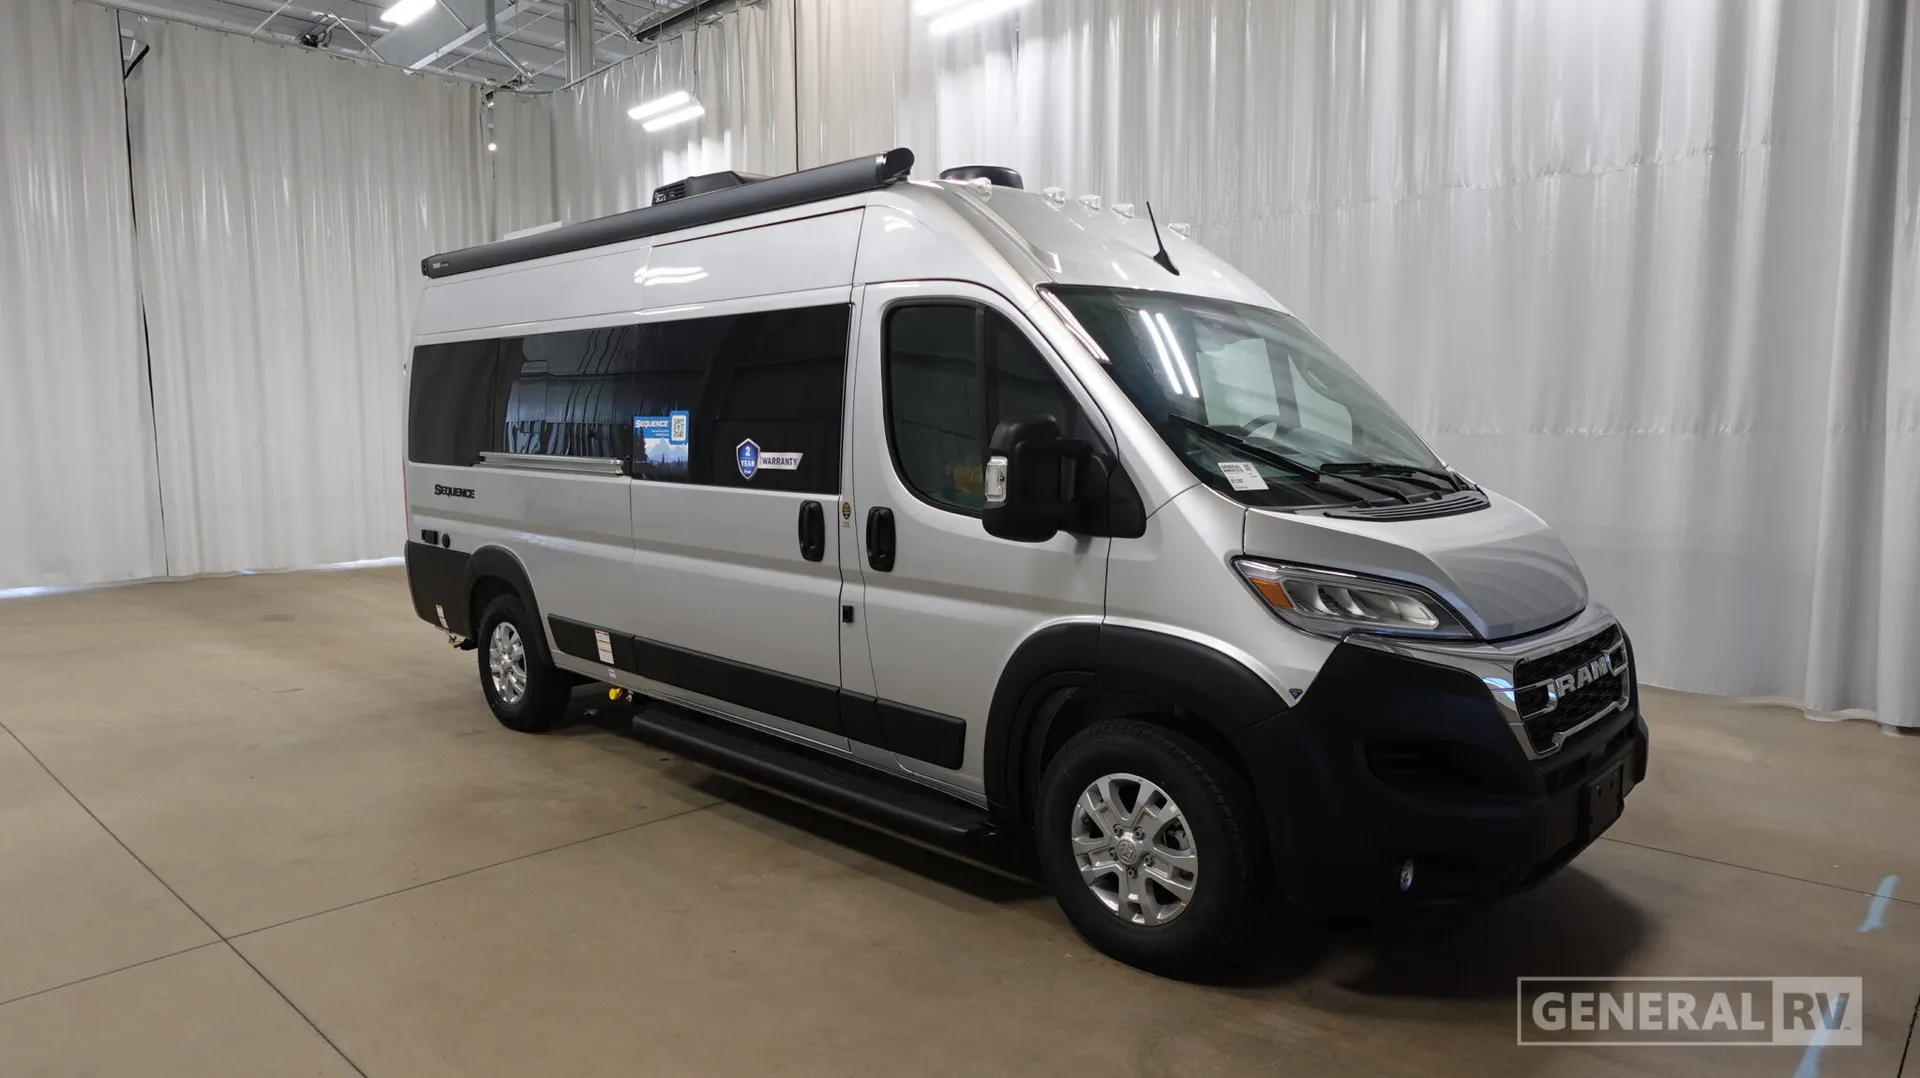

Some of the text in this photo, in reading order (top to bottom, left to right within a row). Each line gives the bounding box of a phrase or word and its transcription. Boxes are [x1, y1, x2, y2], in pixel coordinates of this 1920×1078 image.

[635, 420, 670, 428] SEQUENCE
[745, 446, 751, 457] 2
[740, 459, 756, 467] YEAR
[761, 457, 798, 466] WARRANTY
[434, 483, 476, 499] SEQUENCE
[1554, 656, 1609, 699] RAM
